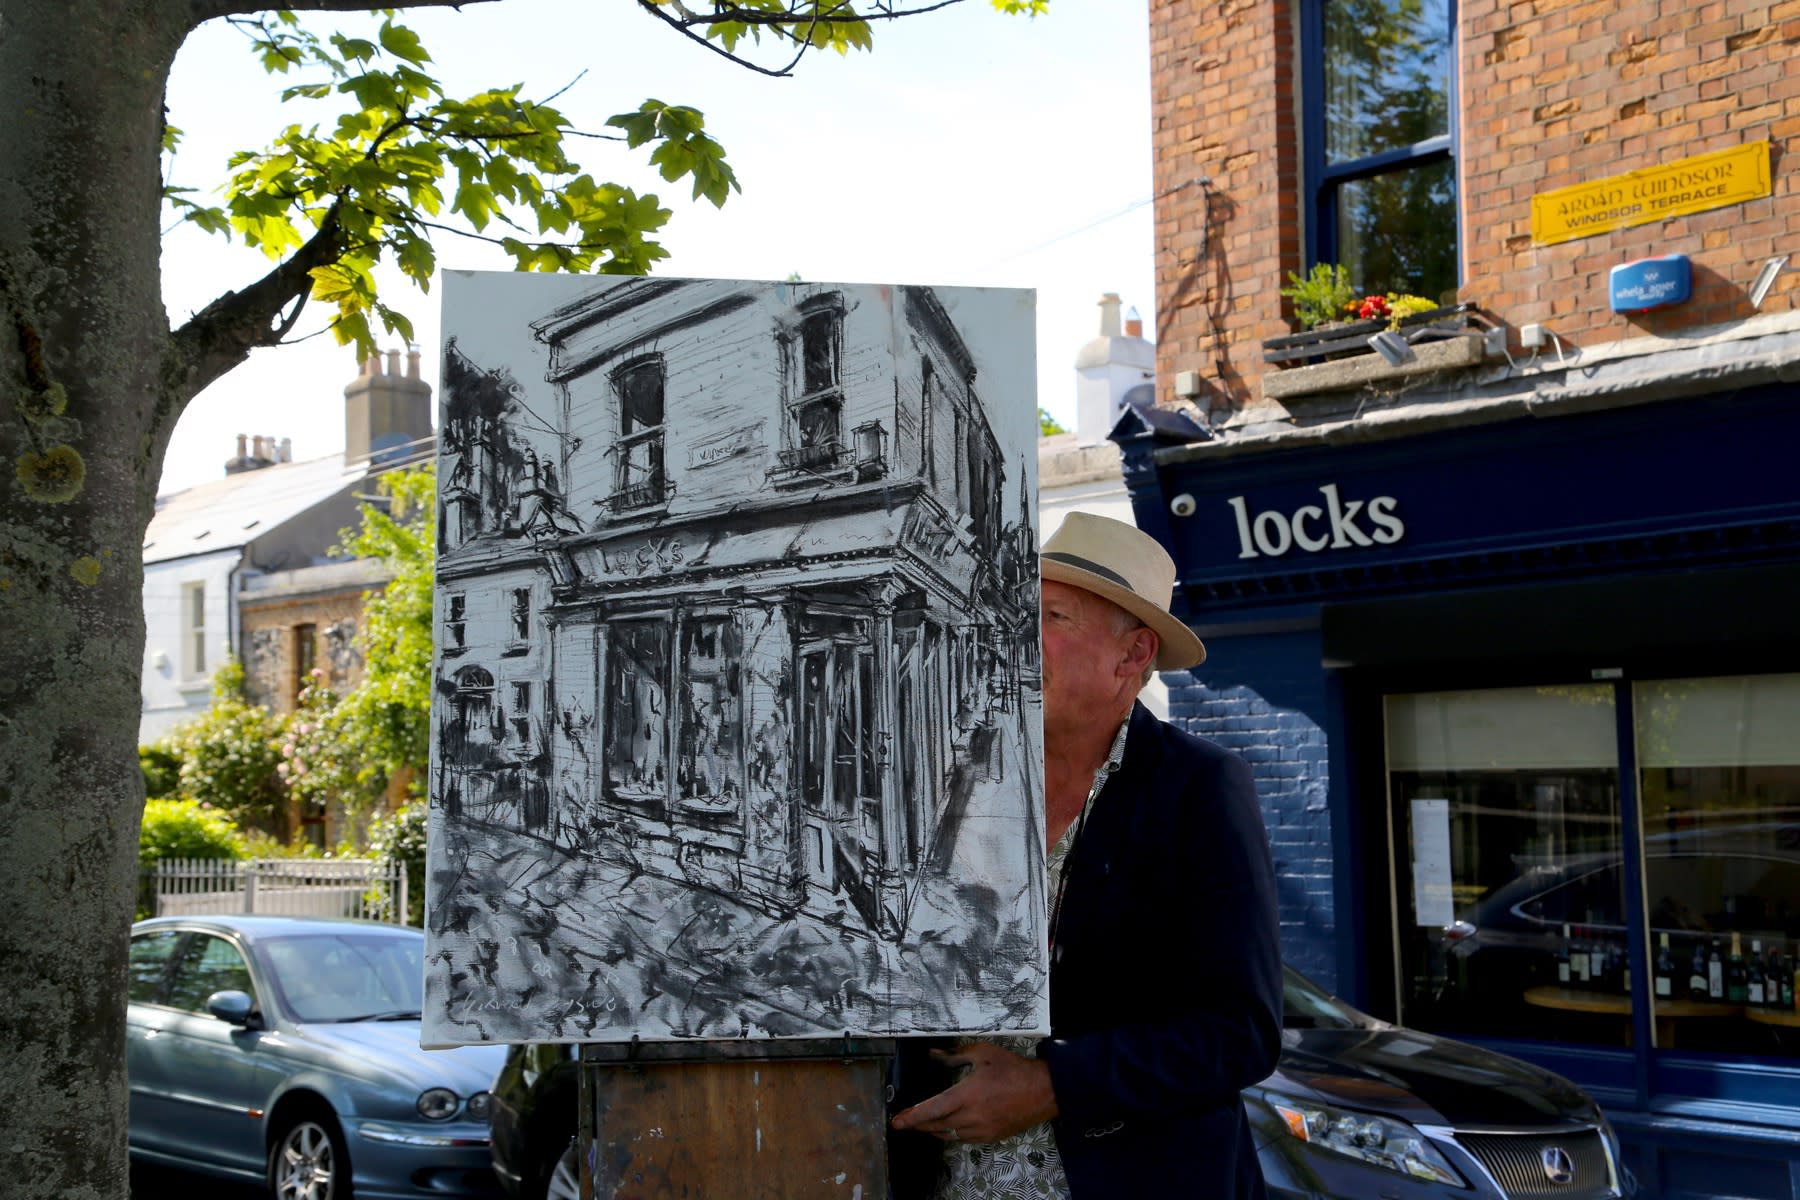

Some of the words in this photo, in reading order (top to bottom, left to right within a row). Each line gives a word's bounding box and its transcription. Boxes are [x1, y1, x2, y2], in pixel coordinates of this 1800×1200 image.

[1565, 203, 1642, 229] WINDSOR
[1649, 184, 1728, 210] TERRACE
[1227, 483, 1405, 559] locks
